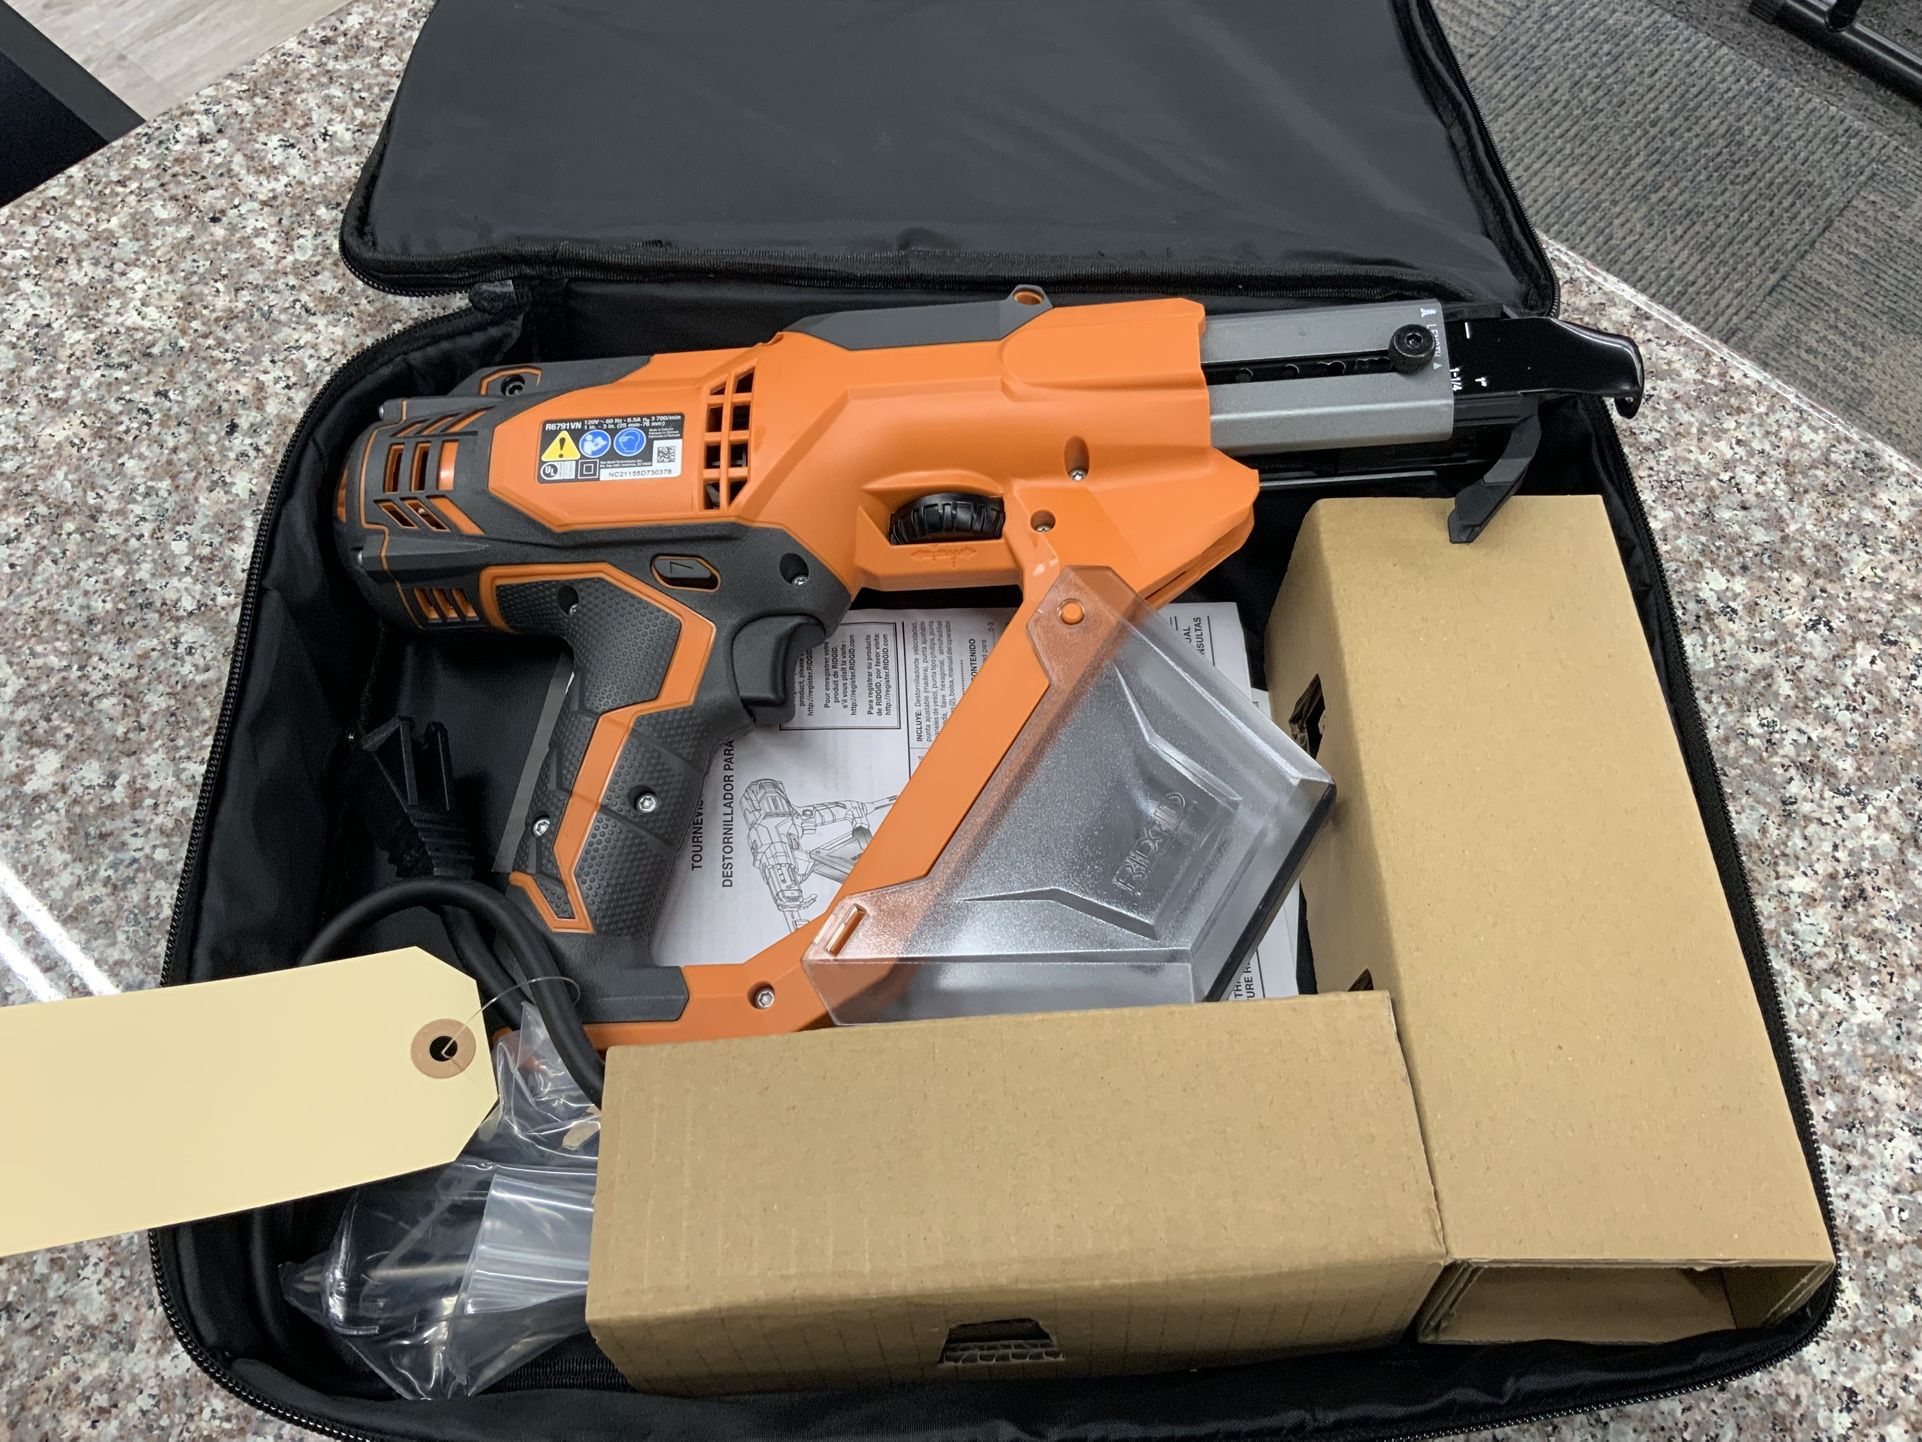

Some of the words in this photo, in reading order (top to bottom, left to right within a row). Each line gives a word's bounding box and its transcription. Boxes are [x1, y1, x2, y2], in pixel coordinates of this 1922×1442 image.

[546, 422, 582, 430] R6791VN
[865, 635, 874, 660] producto
[930, 672, 938, 688] punta
[876, 708, 882, 716] de
[923, 695, 931, 722] ajustable
[933, 708, 938, 716] de
[723, 740, 735, 771] PARA
[722, 775, 735, 887] DESTORNILLADOR
